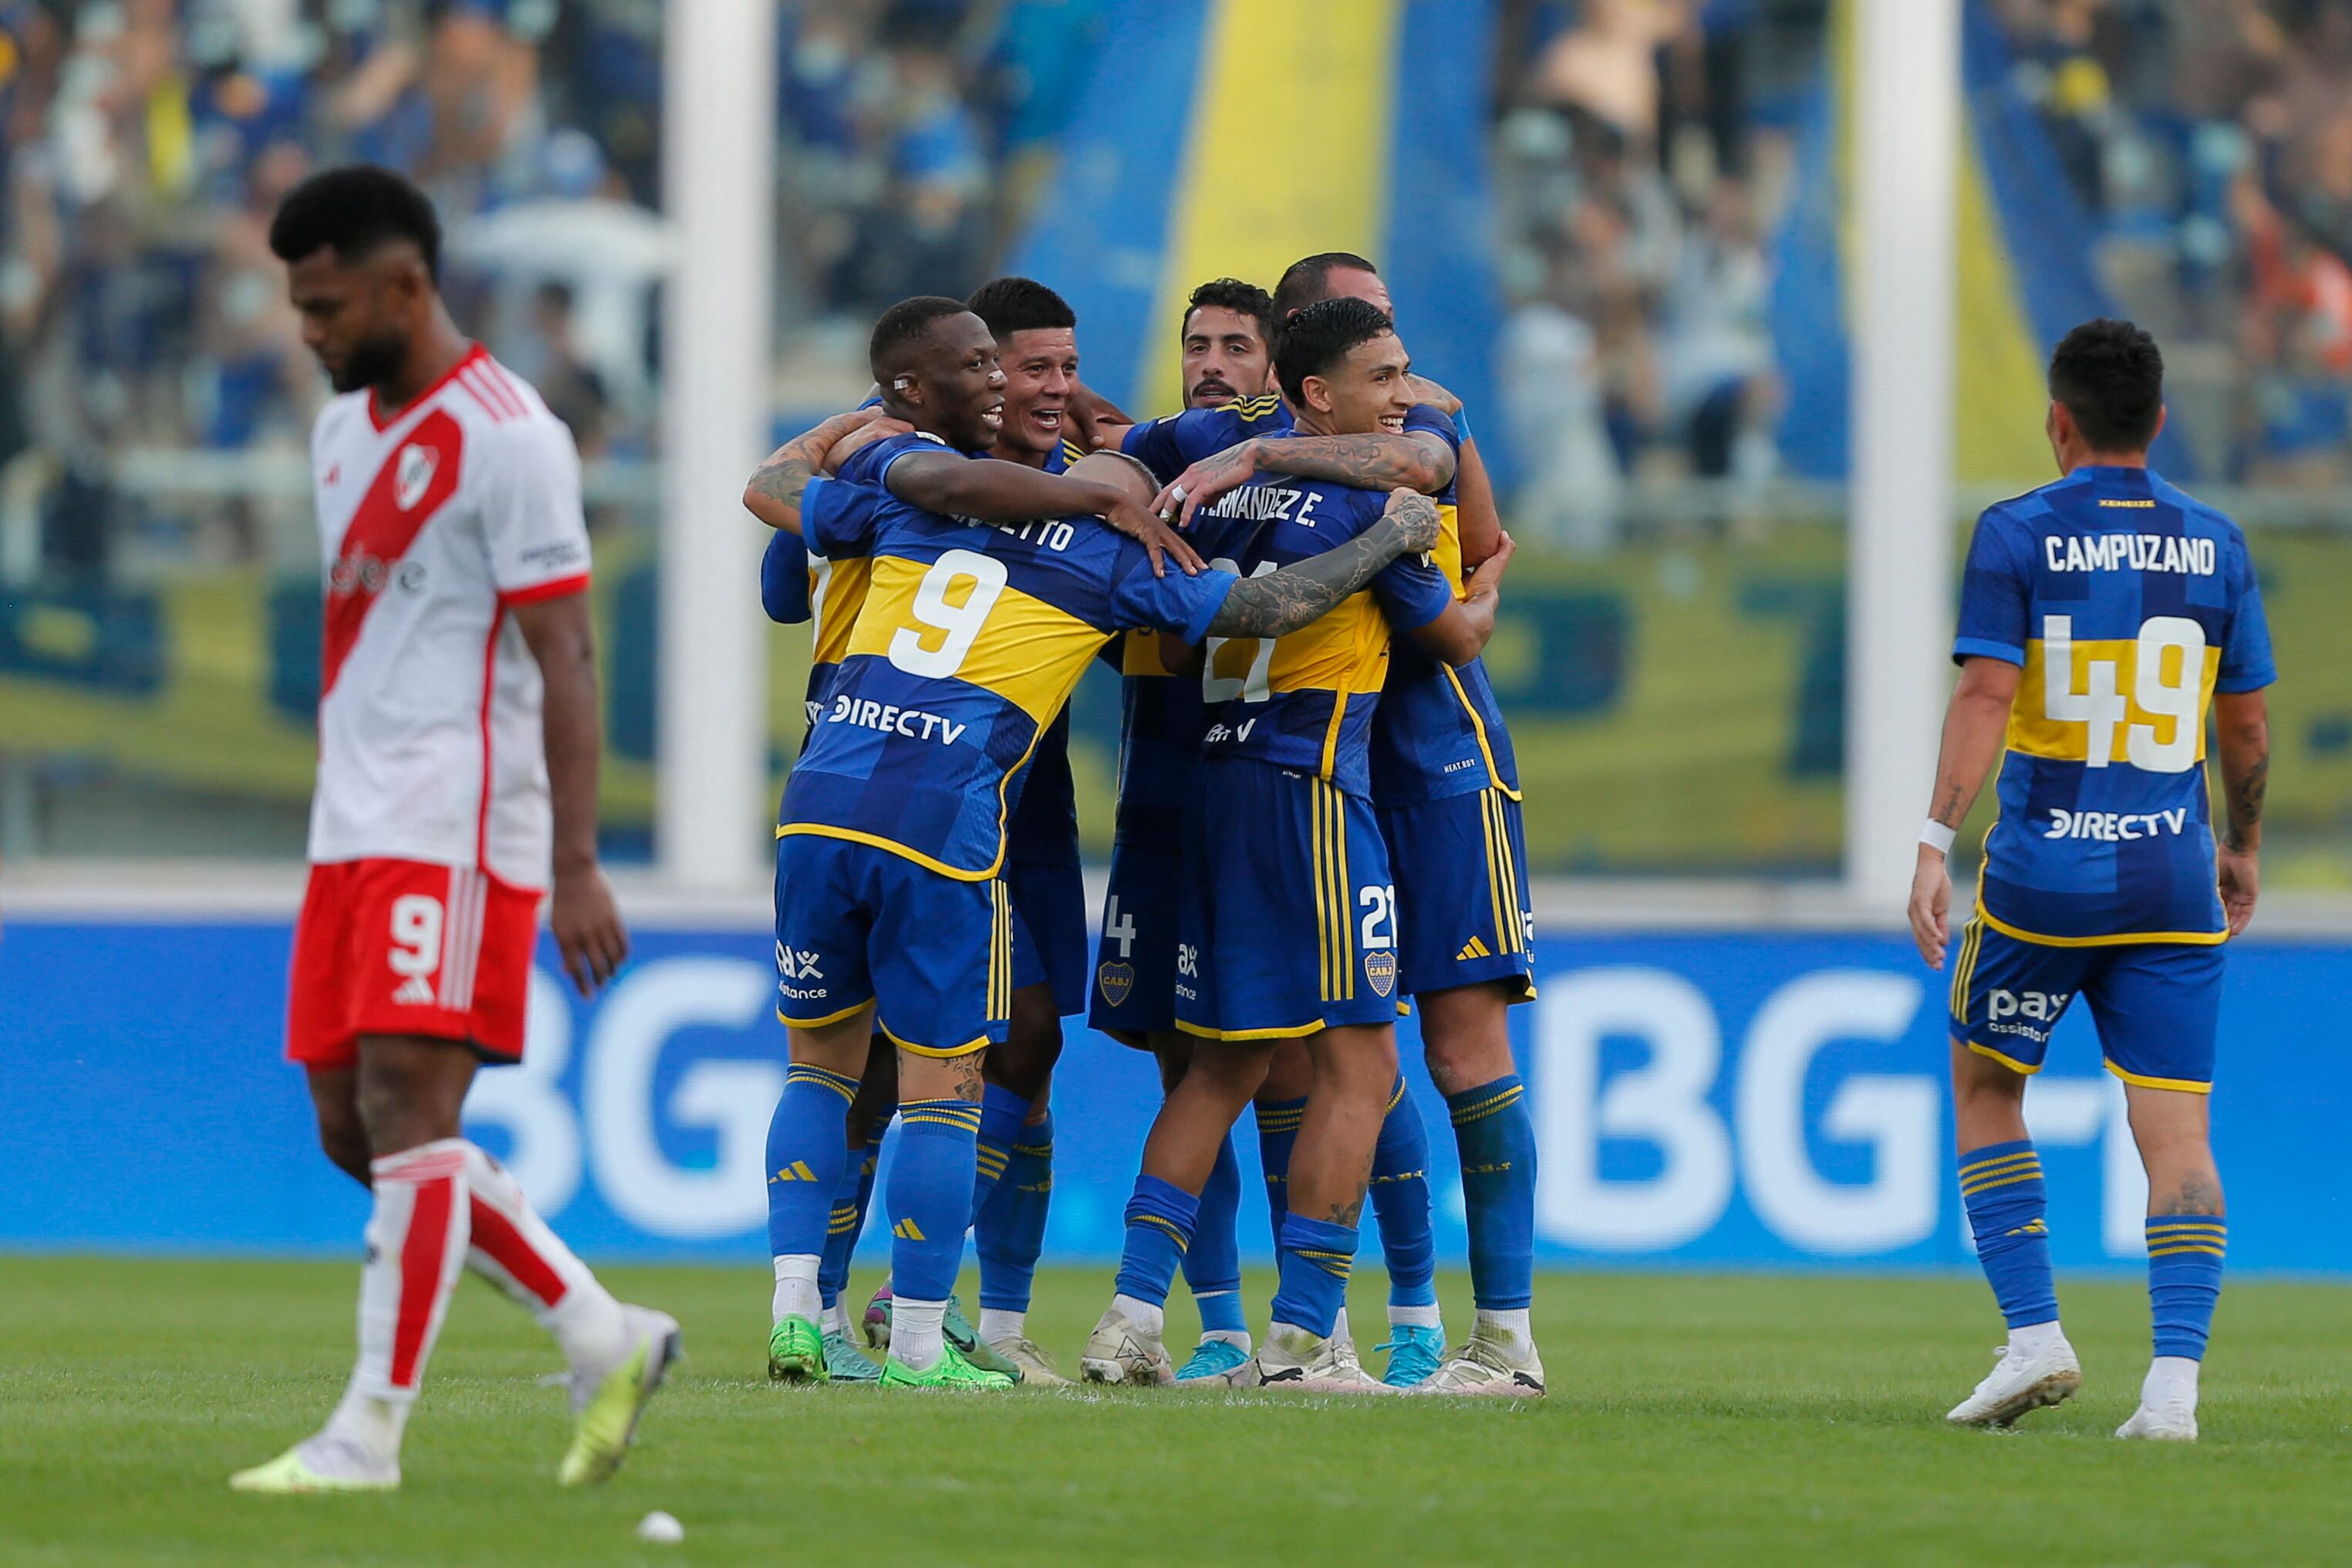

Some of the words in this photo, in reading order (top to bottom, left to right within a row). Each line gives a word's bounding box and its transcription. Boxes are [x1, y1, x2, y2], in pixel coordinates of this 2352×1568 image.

[1295, 491, 1324, 528] E.
[2045, 534, 2216, 576] CAMPUZANO
[888, 548, 1008, 679] 9
[2043, 615, 2207, 773] 49
[828, 695, 967, 746] DIRECTV
[2043, 808, 2187, 841] DIRECTV
[387, 893, 444, 977] 9
[1106, 895, 1136, 958] 4
[1359, 885, 1398, 949] 21
[1103, 976, 1130, 986] CABJ
[1178, 943, 1198, 978] ax
[1369, 966, 1392, 977] CABJ
